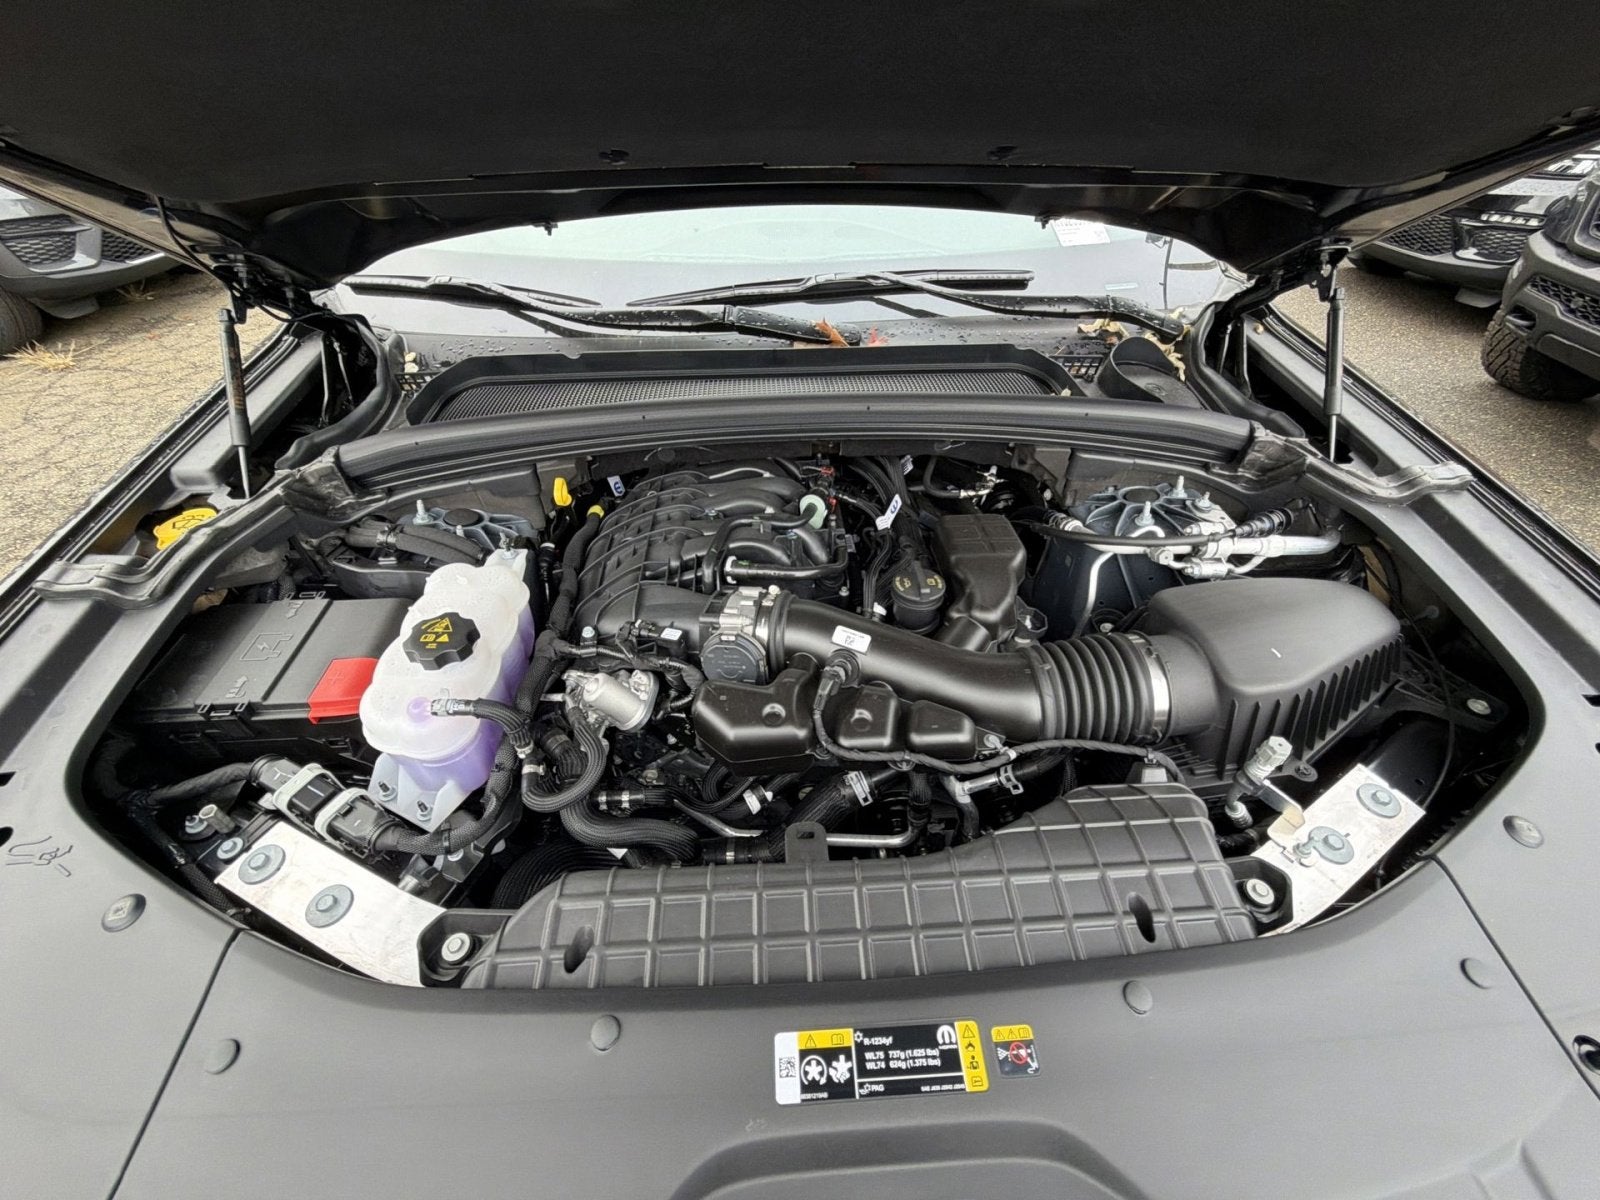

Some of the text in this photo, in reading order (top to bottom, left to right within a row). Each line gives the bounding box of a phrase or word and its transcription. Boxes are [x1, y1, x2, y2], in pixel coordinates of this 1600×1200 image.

[863, 1036, 893, 1046] R-1234yf
[864, 1050, 885, 1060] WL75
[888, 1050, 905, 1060] 737g
[865, 1061, 886, 1070] WL74
[871, 1084, 885, 1092] PAG
